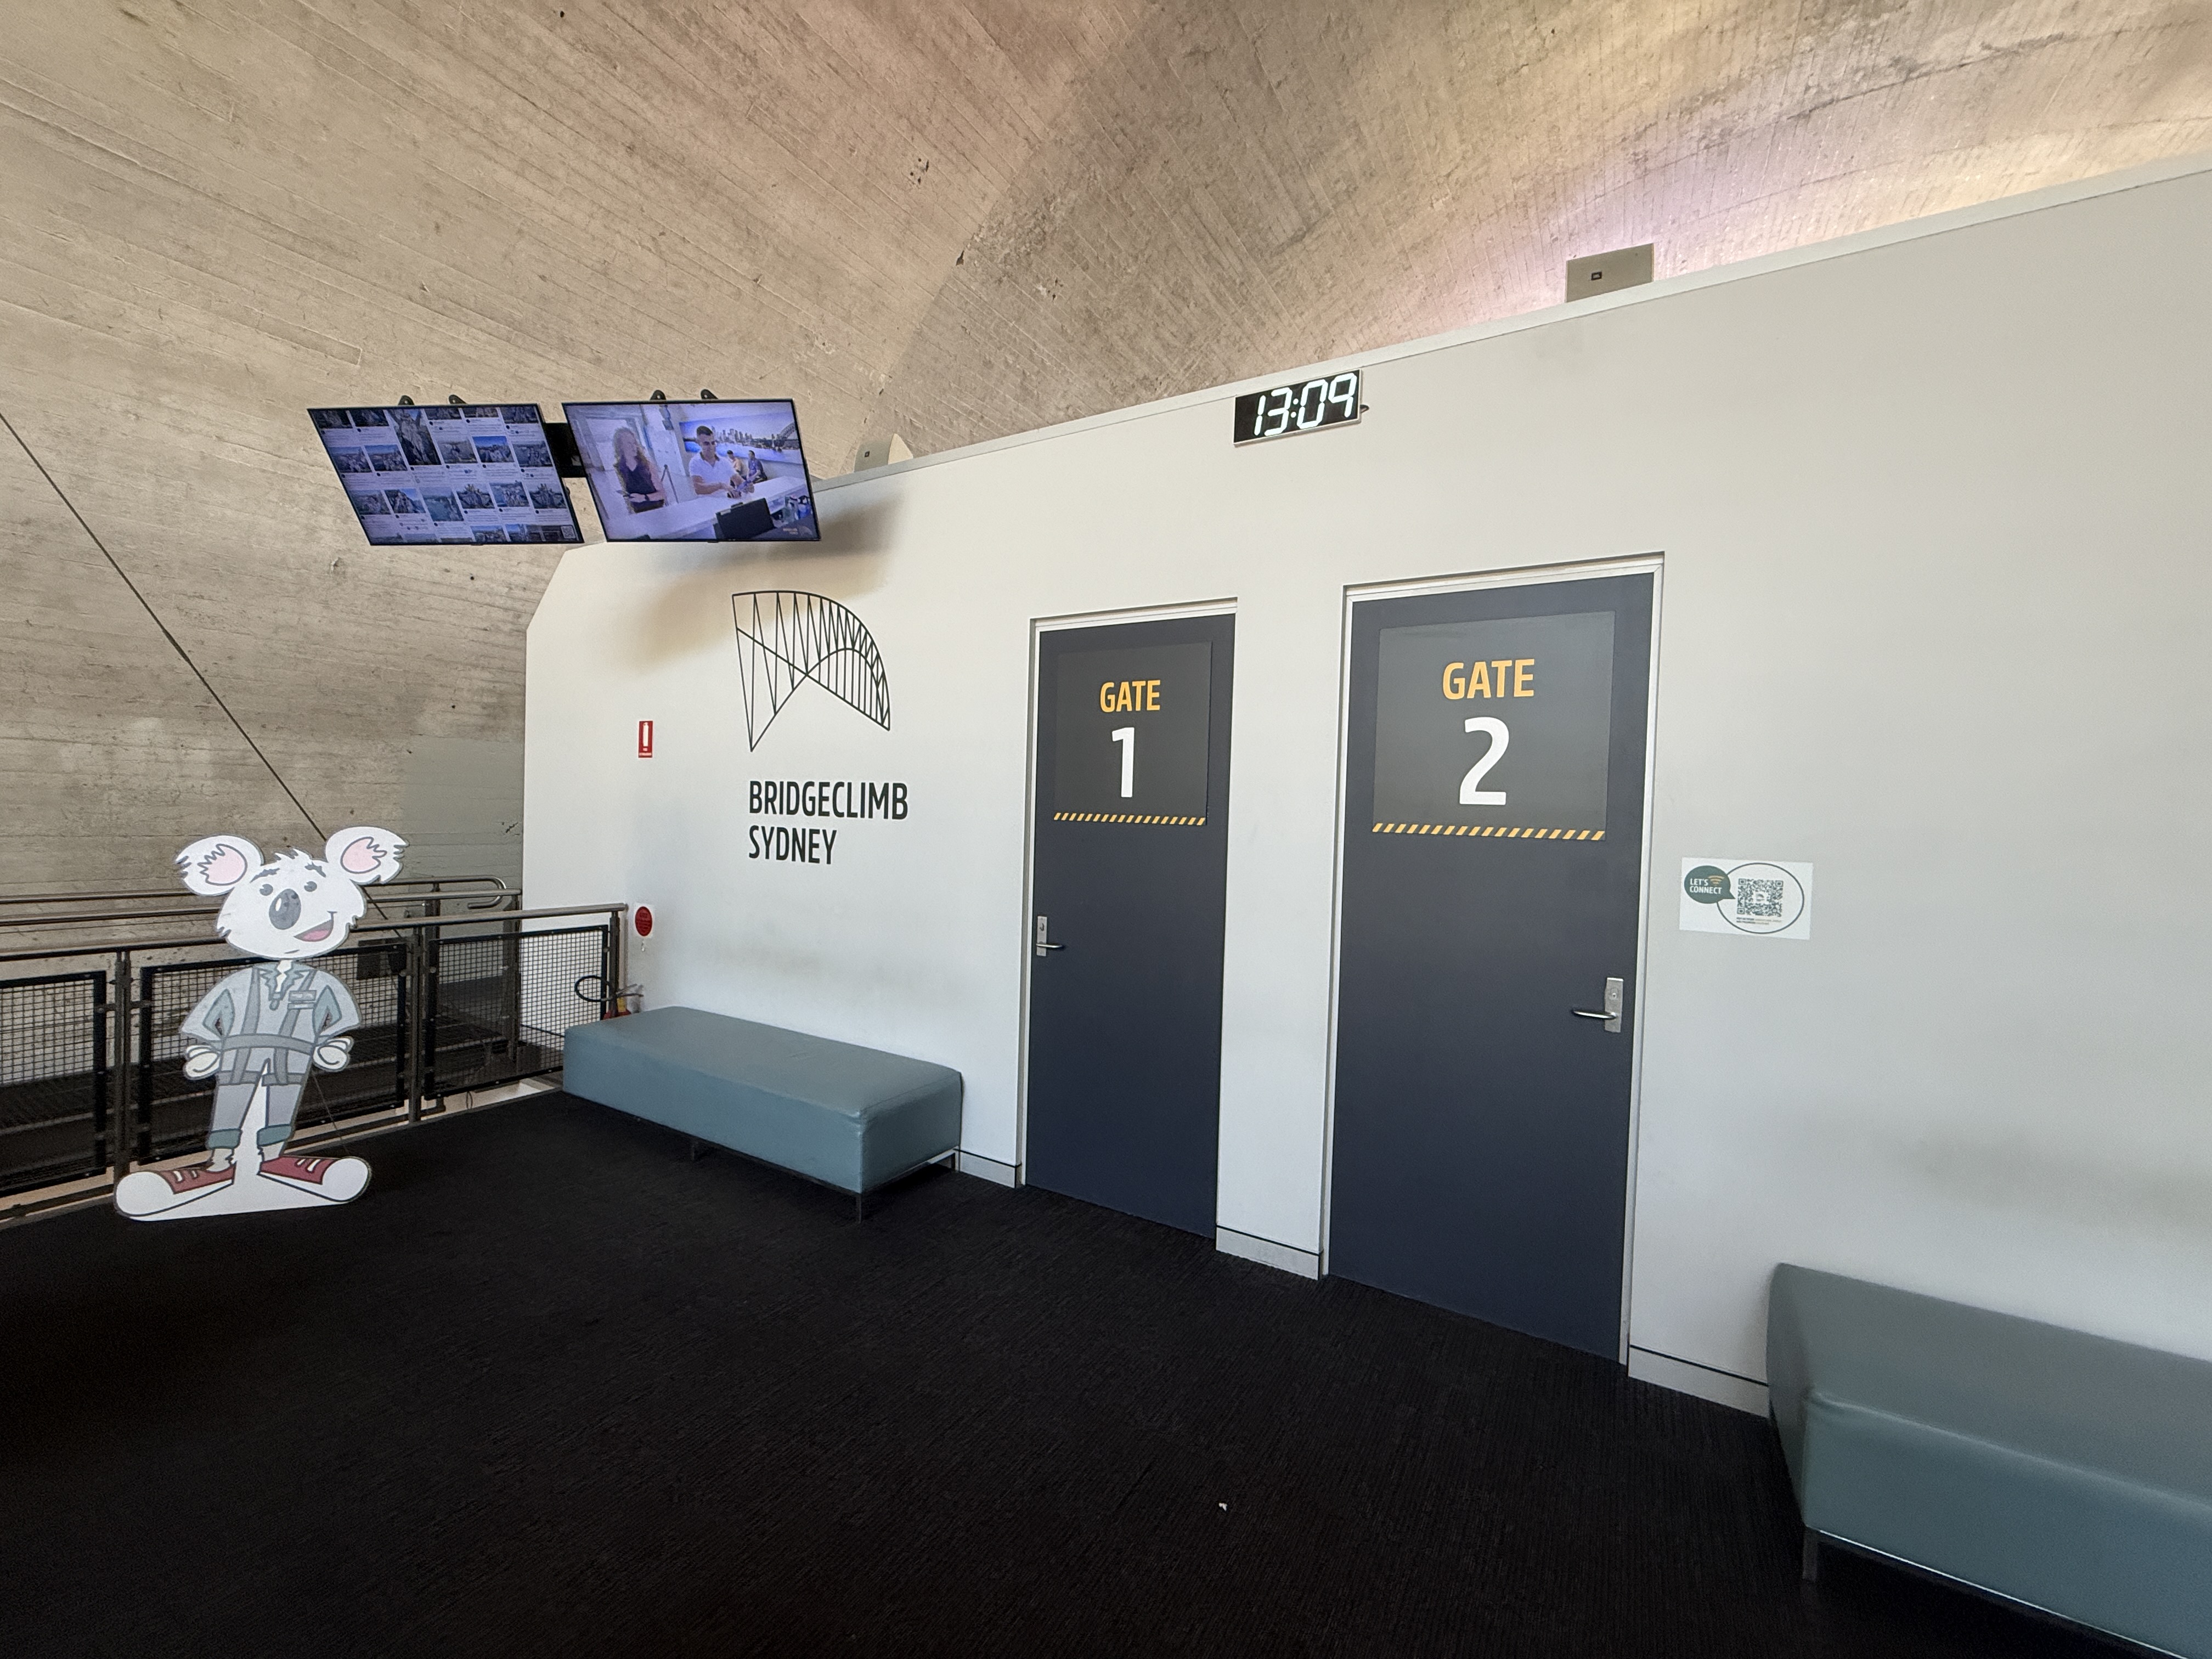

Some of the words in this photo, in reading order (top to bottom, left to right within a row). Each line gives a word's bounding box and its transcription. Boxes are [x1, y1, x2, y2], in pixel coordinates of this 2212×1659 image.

[1254, 373, 1357, 436] 13:09
[1100, 680, 1161, 713] GATE
[1442, 658, 1535, 700] GATE
[1111, 727, 1135, 798] 1
[1459, 716, 1509, 805] 2
[749, 780, 909, 820] BRIDGECLIMB
[749, 825, 837, 865] SYDNEY
[1689, 885, 1722, 894] CONNECT
[1690, 878, 1709, 887] LET'S
